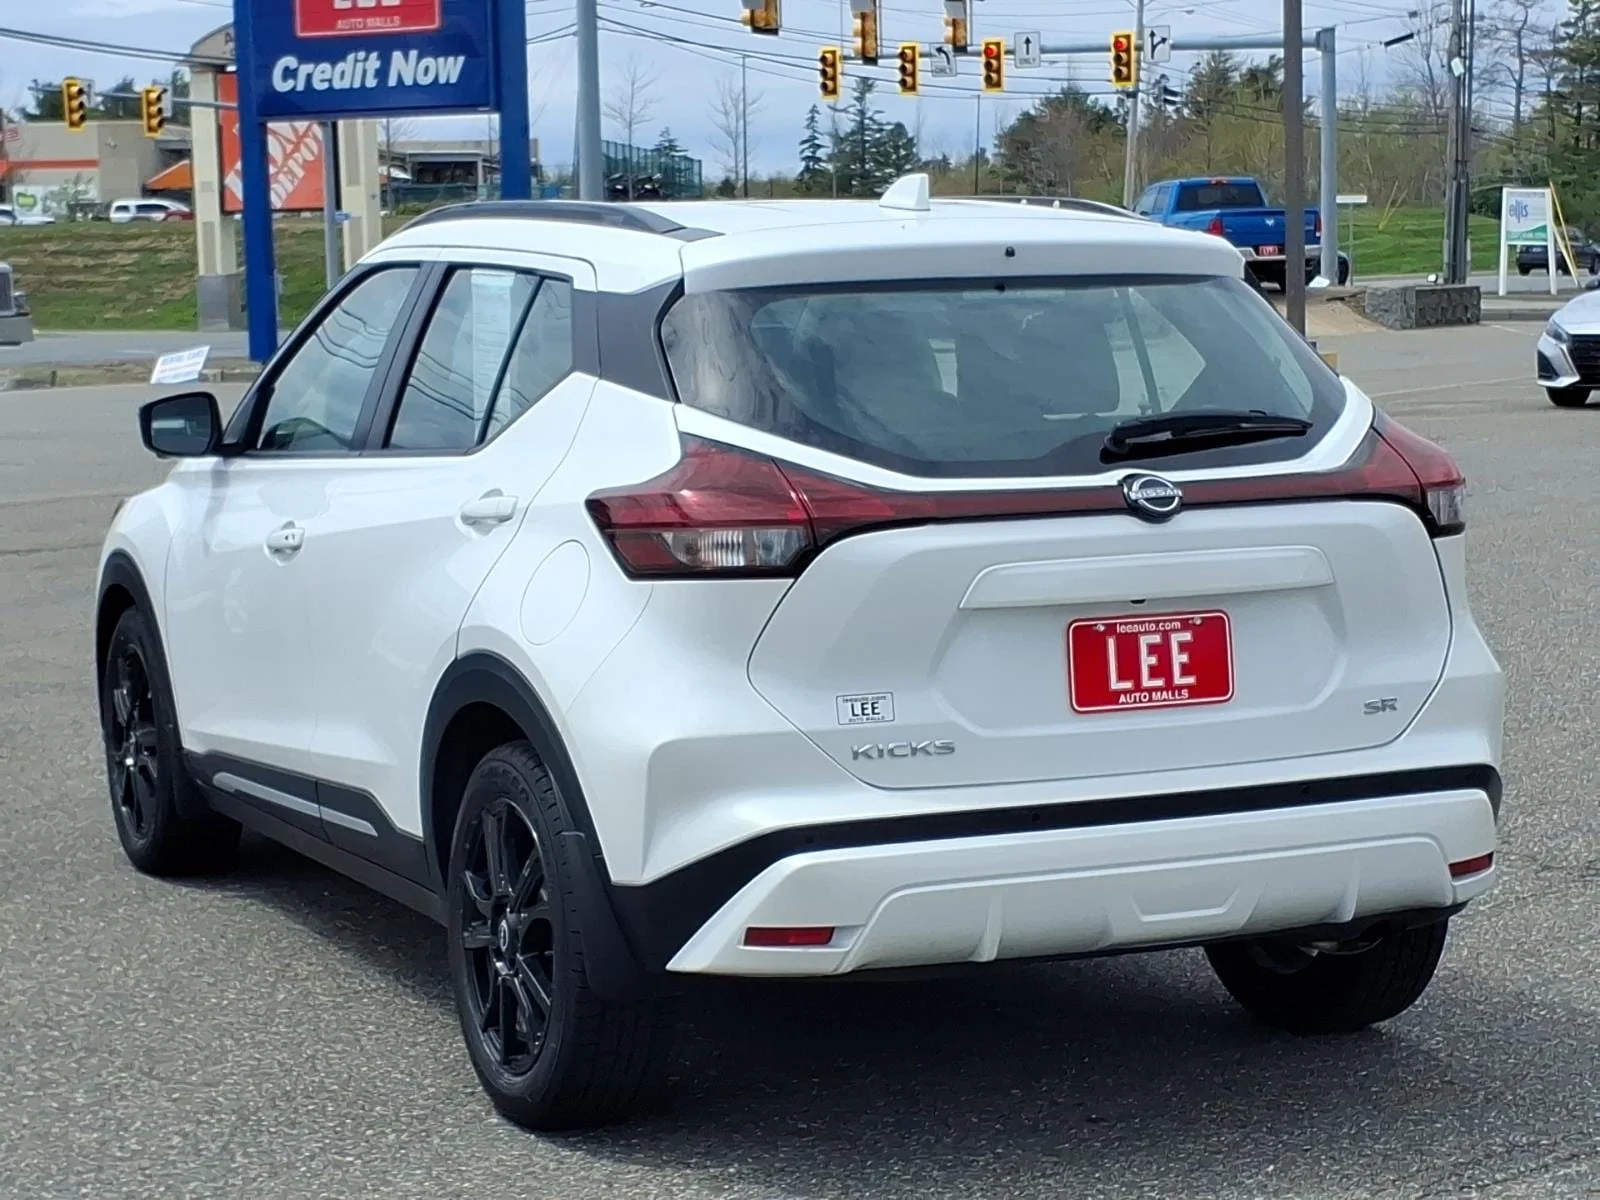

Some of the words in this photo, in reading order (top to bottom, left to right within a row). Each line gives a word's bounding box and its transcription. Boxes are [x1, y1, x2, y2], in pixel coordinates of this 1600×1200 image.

[336, 17, 364, 29] AUTO
[271, 50, 381, 92] Credit
[387, 50, 466, 87] Now
[1129, 486, 1183, 500] NISSAN
[1116, 620, 1182, 634] leeauto.com
[1106, 630, 1198, 692] LEE
[1118, 691, 1150, 704] AUTO
[1151, 689, 1189, 702] MALLS
[850, 701, 881, 717] LEE
[1363, 696, 1398, 715] SR
[851, 740, 956, 760] KICKS
